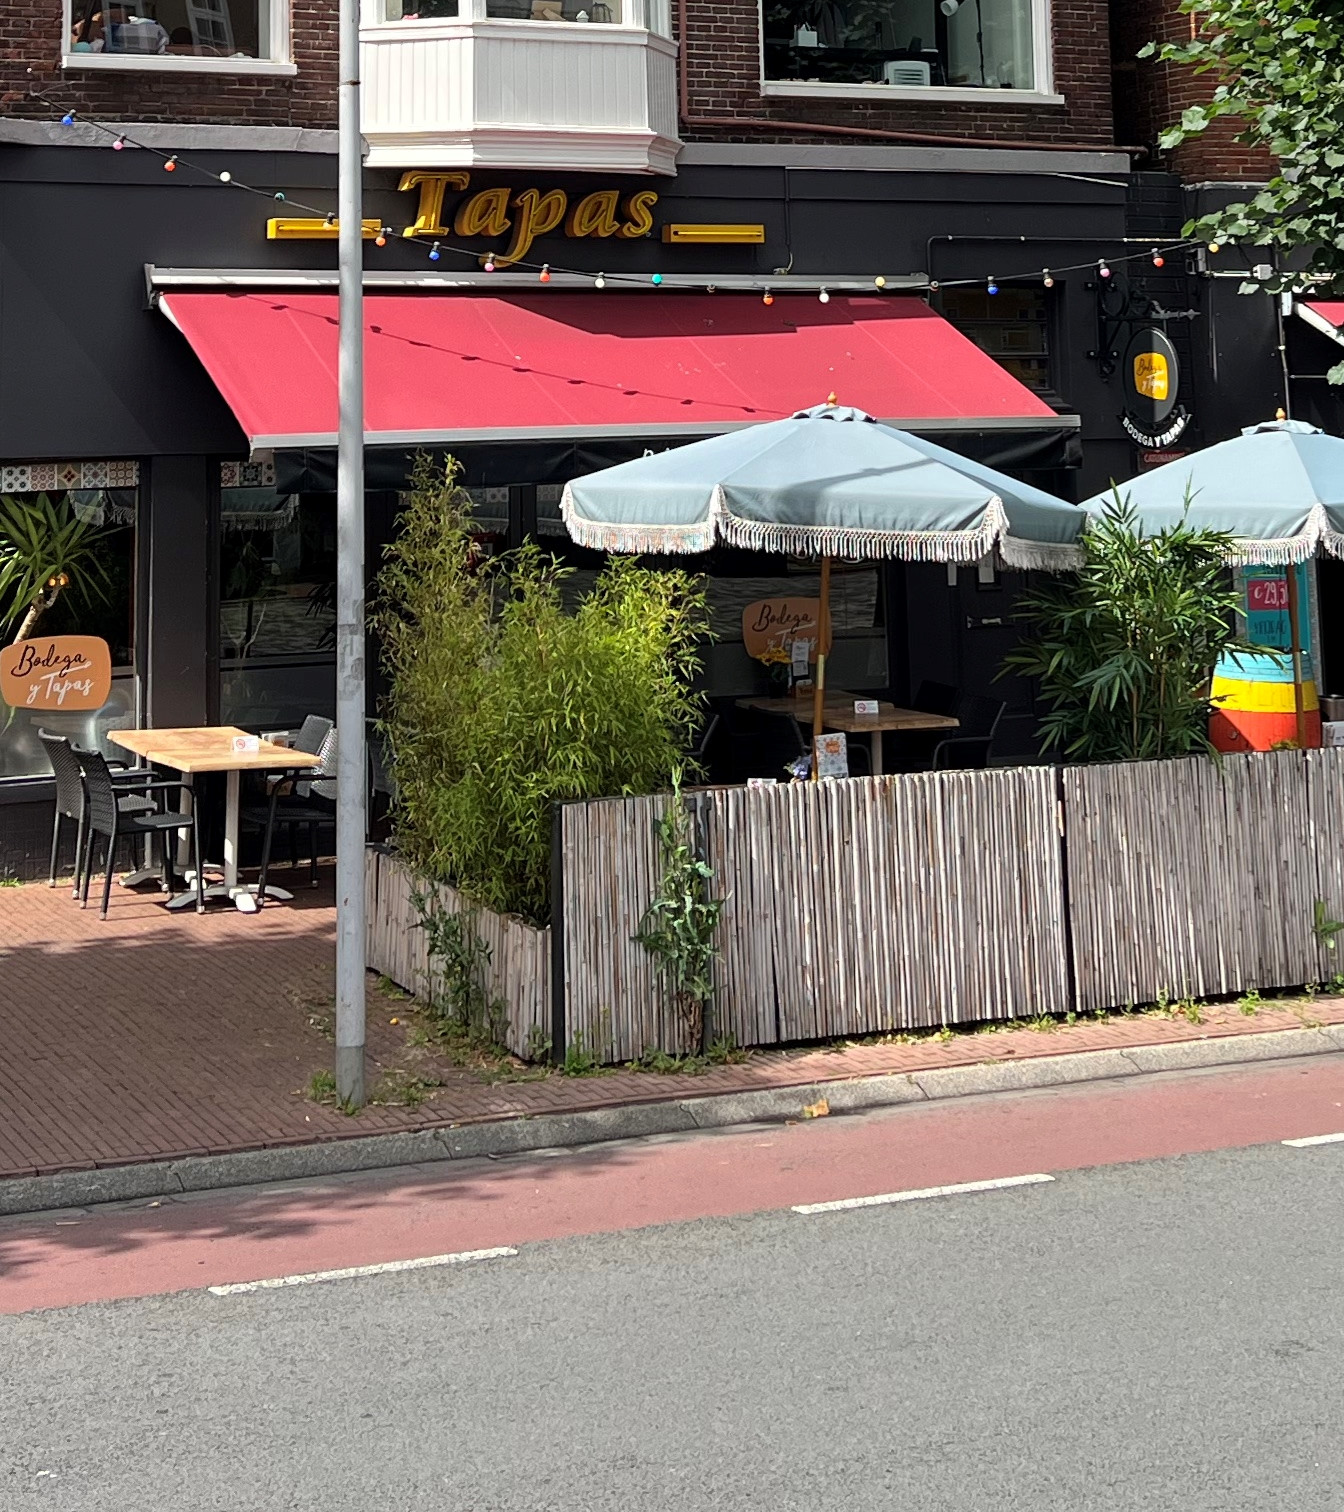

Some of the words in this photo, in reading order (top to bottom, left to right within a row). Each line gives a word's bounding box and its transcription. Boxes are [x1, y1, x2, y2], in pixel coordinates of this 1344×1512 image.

[398, 171, 658, 268] Tapas
[1122, 416, 1154, 447] BODEGA
[1154, 436, 1161, 447] Y
[1161, 416, 1185, 445] TAPAS
[752, 604, 813, 634] Bodega
[11, 643, 87, 678] Bodega
[26, 683, 42, 705] y
[40, 661, 94, 705] Tapas
